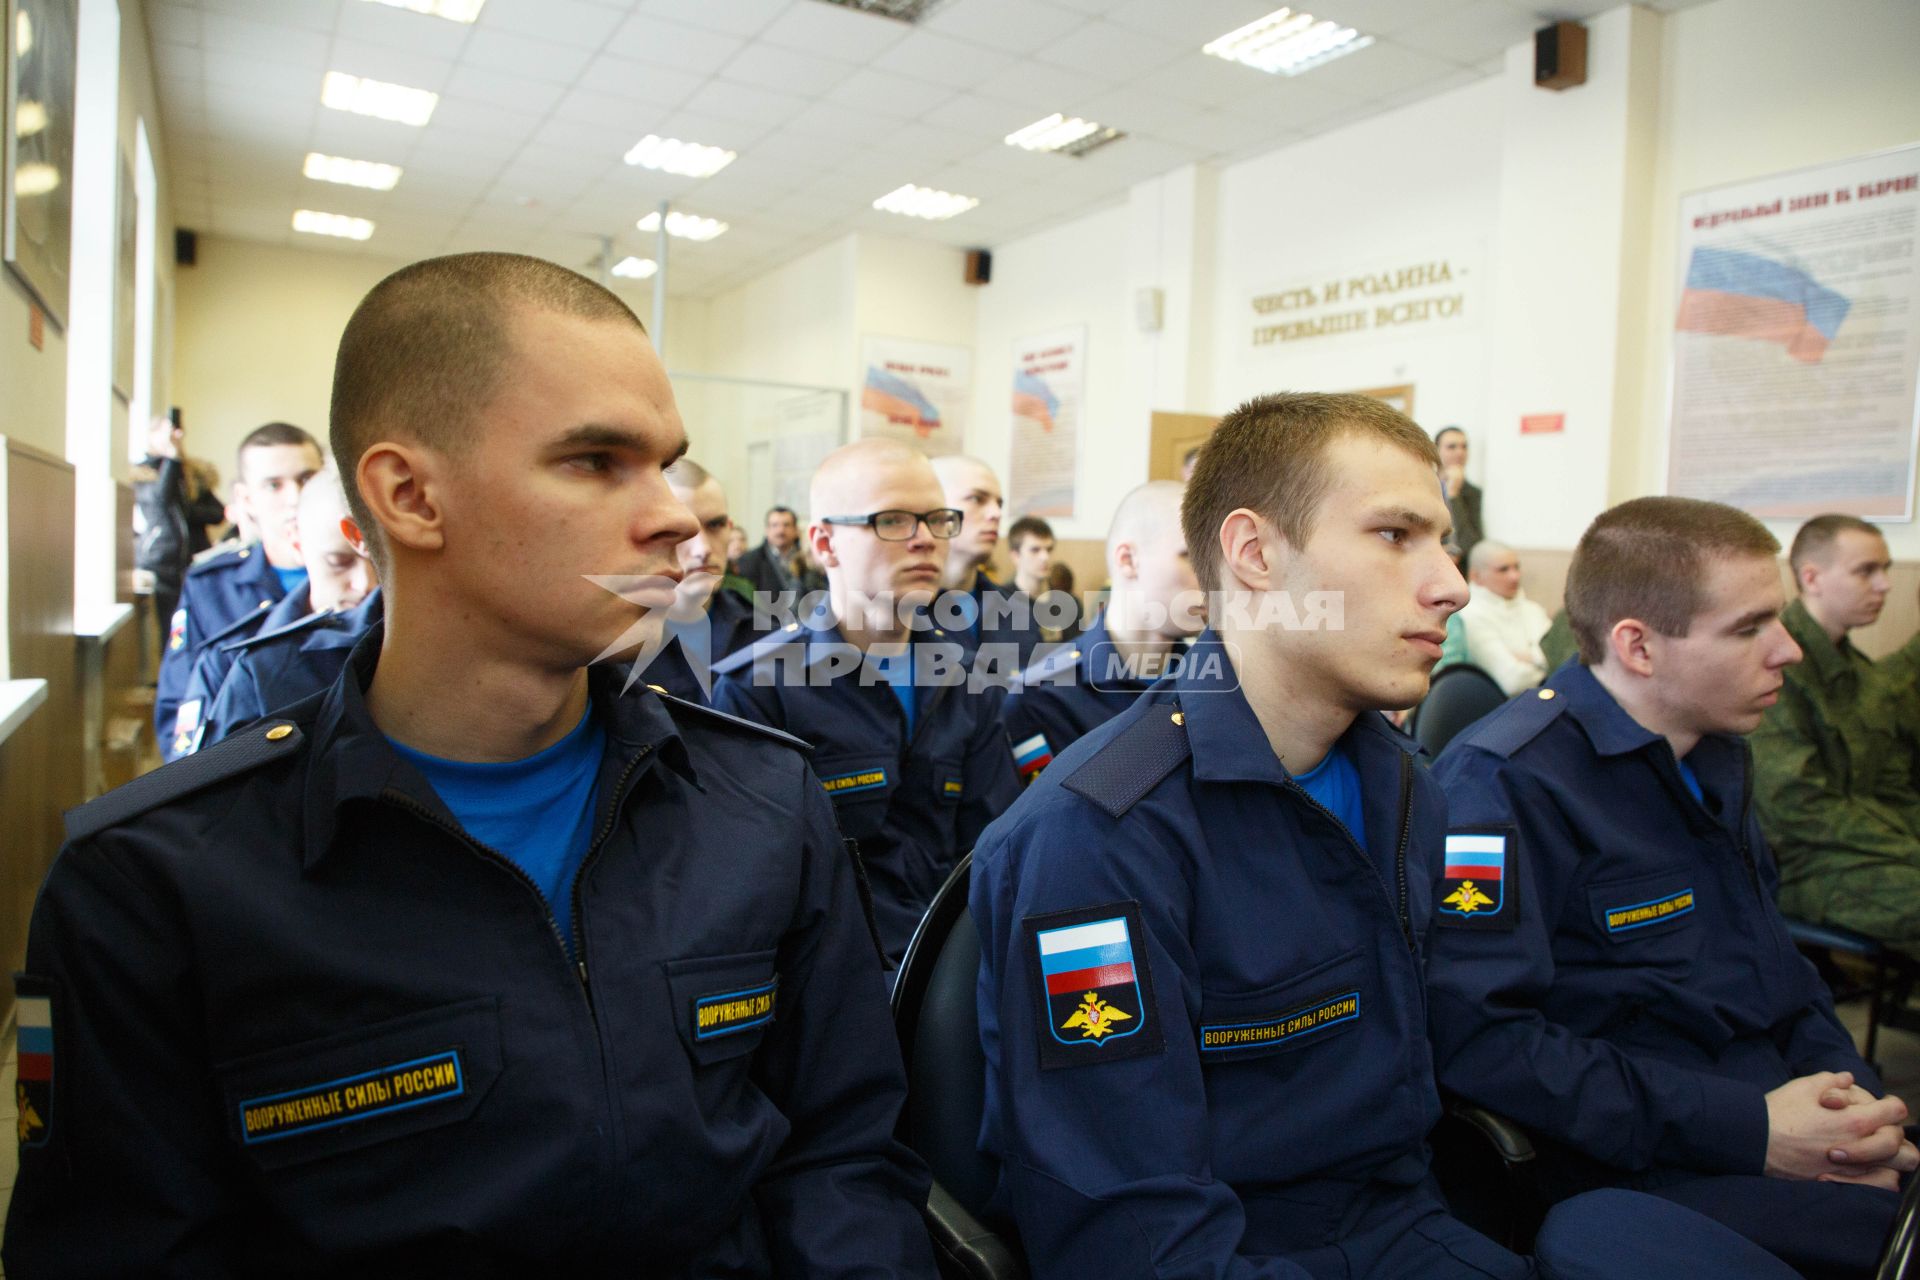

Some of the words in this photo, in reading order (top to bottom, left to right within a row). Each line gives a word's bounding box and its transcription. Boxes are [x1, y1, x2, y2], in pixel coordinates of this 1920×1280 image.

[1252, 286, 1317, 316] ЧЕСТЬ
[1323, 281, 1342, 303] И
[1349, 261, 1453, 299] РОДИНА
[1253, 310, 1367, 346] ПРЕВЫШЕ
[1375, 293, 1465, 328] ВСЕГО!
[699, 998, 755, 1027] ВООРУЖЕННЫЕ
[1205, 1025, 1285, 1045] ВООРУЖЕННЫЕ
[1288, 1012, 1316, 1033] СИЛЫ
[1319, 999, 1355, 1022] РОССИИ
[246, 1091, 342, 1132] ВООРУЖЕННЫЕ
[345, 1080, 391, 1110] СИЛЫ
[395, 1062, 456, 1098] РОССИИ
